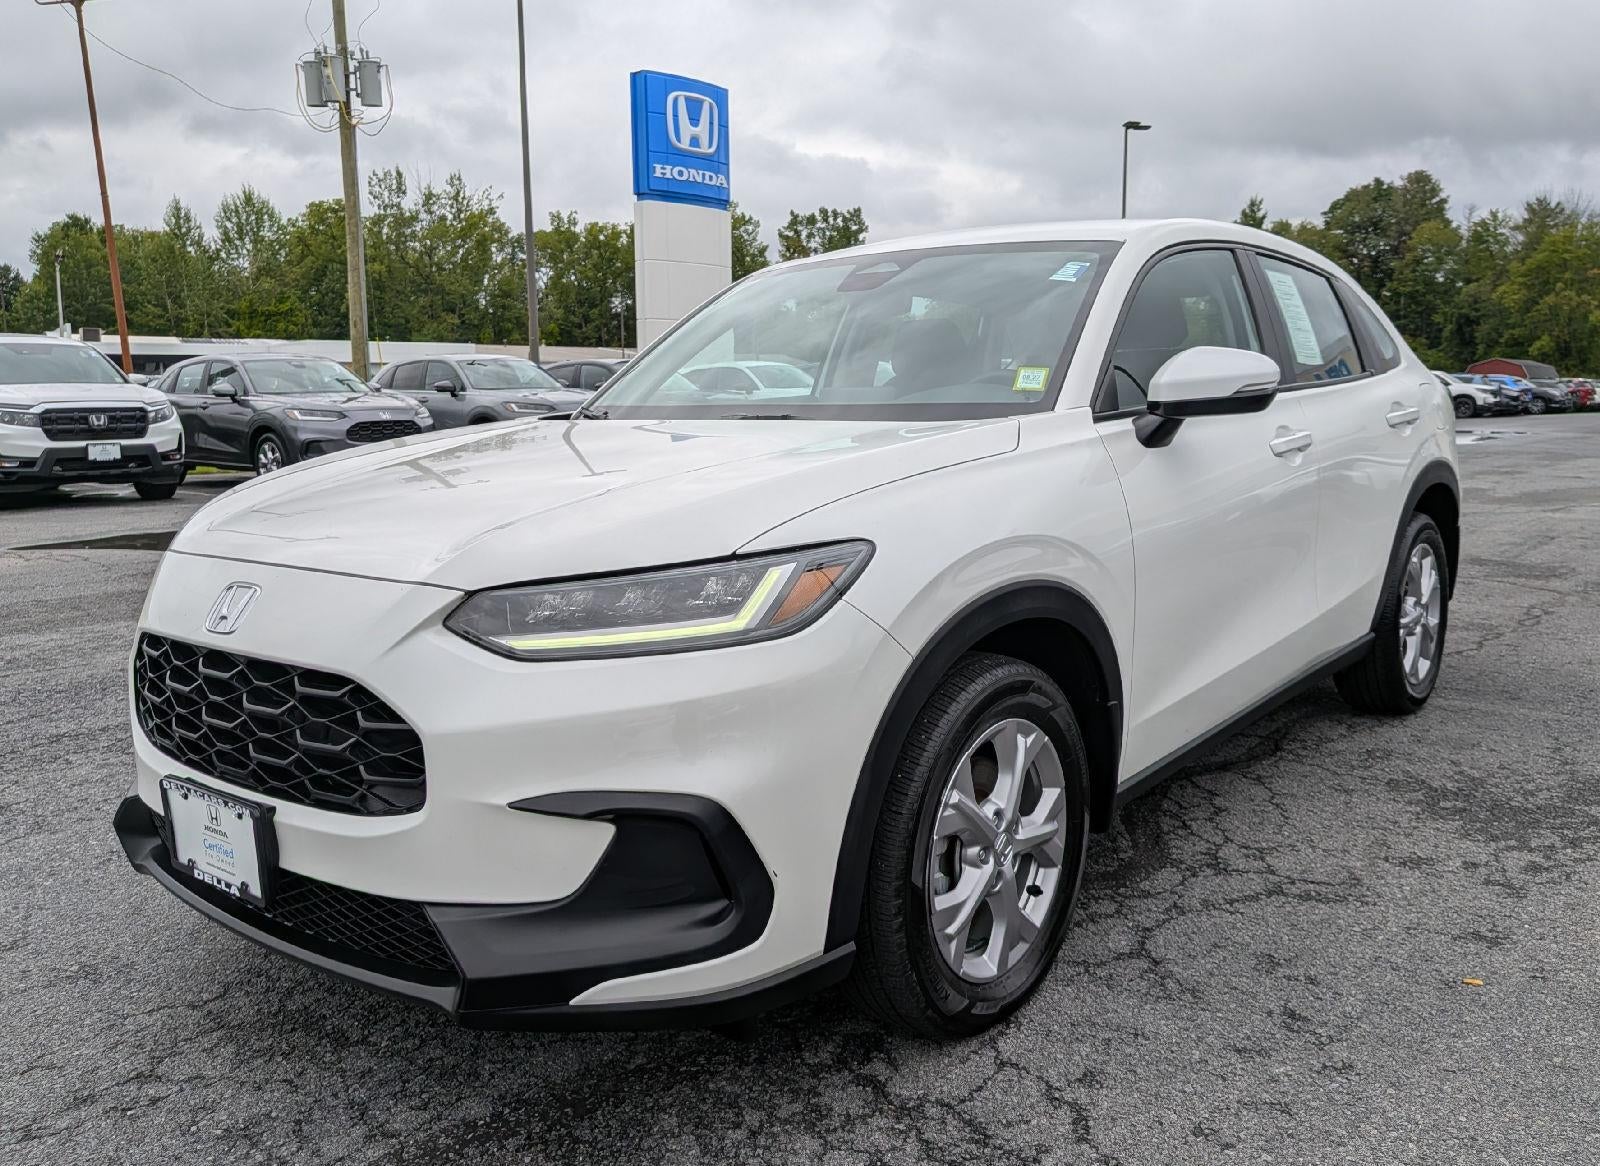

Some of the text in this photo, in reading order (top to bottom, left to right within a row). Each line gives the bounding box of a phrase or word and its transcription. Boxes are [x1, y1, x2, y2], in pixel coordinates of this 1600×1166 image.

[653, 163, 728, 188] HONDA
[162, 780, 251, 817] DELLACARS.COM
[203, 824, 229, 839] HONDA
[203, 838, 234, 859] Certified
[193, 868, 241, 897] DELLA
